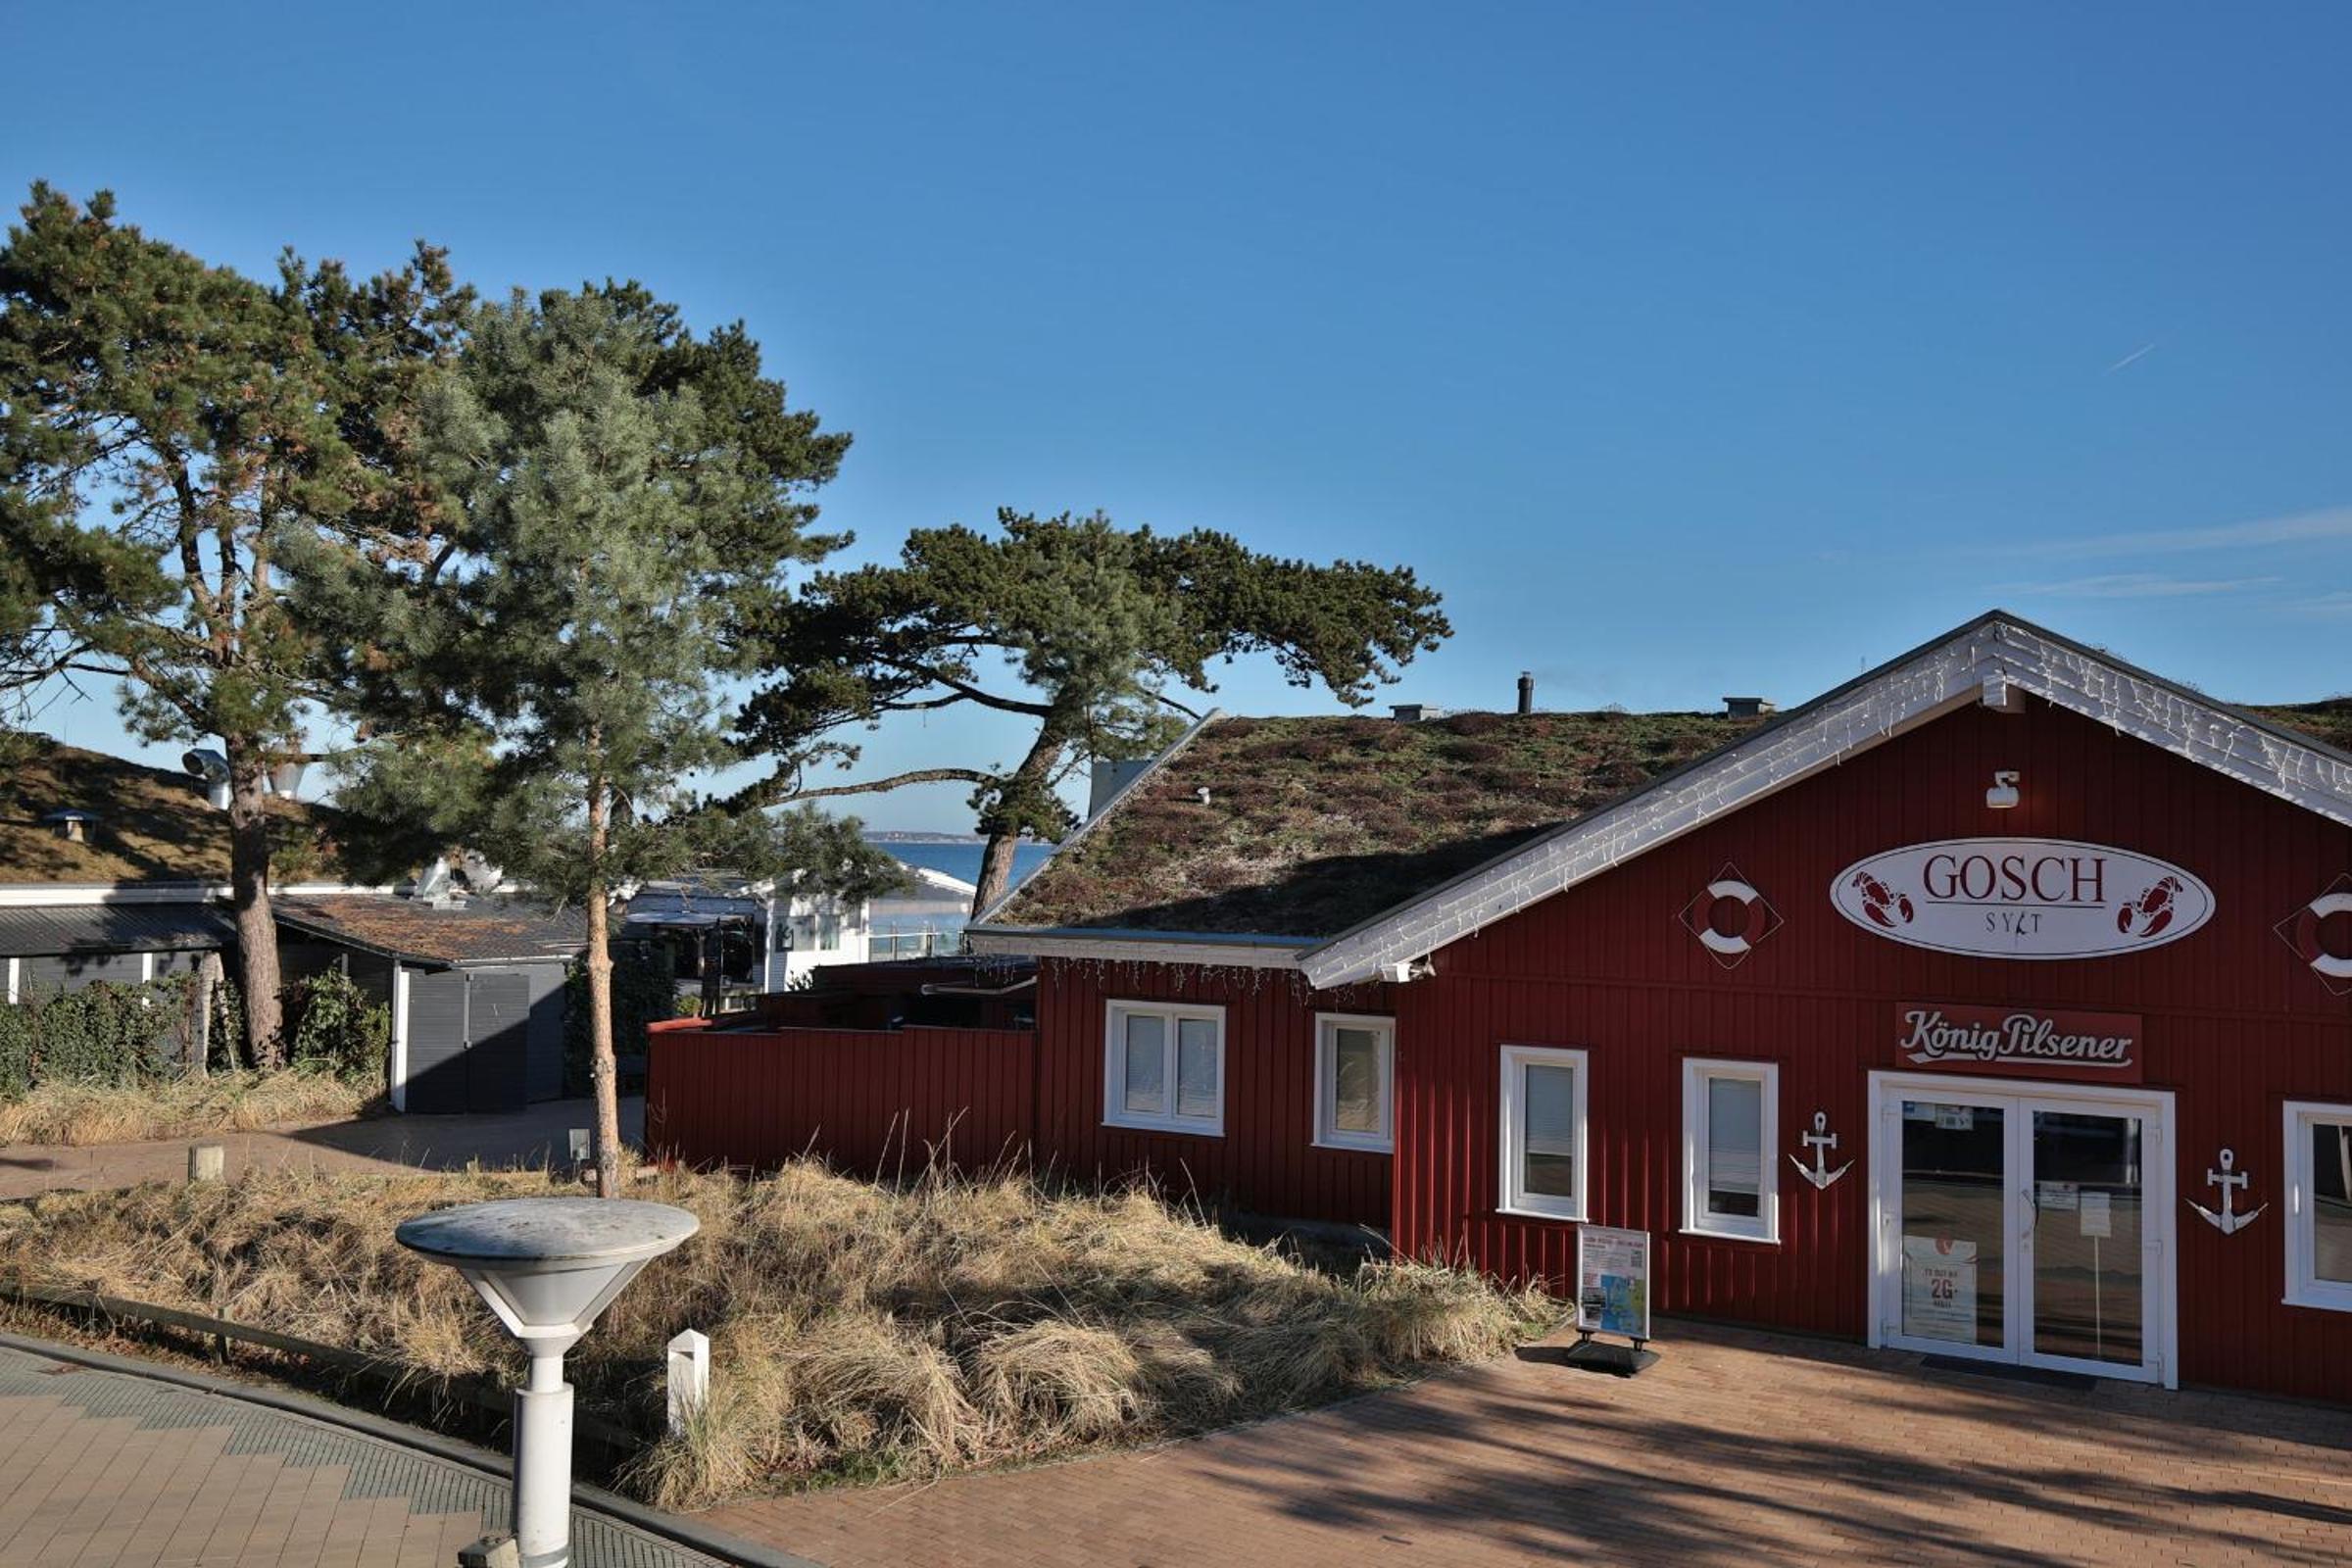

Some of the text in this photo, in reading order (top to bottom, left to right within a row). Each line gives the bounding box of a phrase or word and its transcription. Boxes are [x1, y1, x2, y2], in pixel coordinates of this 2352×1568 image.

[1924, 854, 2107, 903] GOSCH
[1986, 911, 2042, 935] SYLT
[1900, 1011, 2132, 1060] König Pilsener
